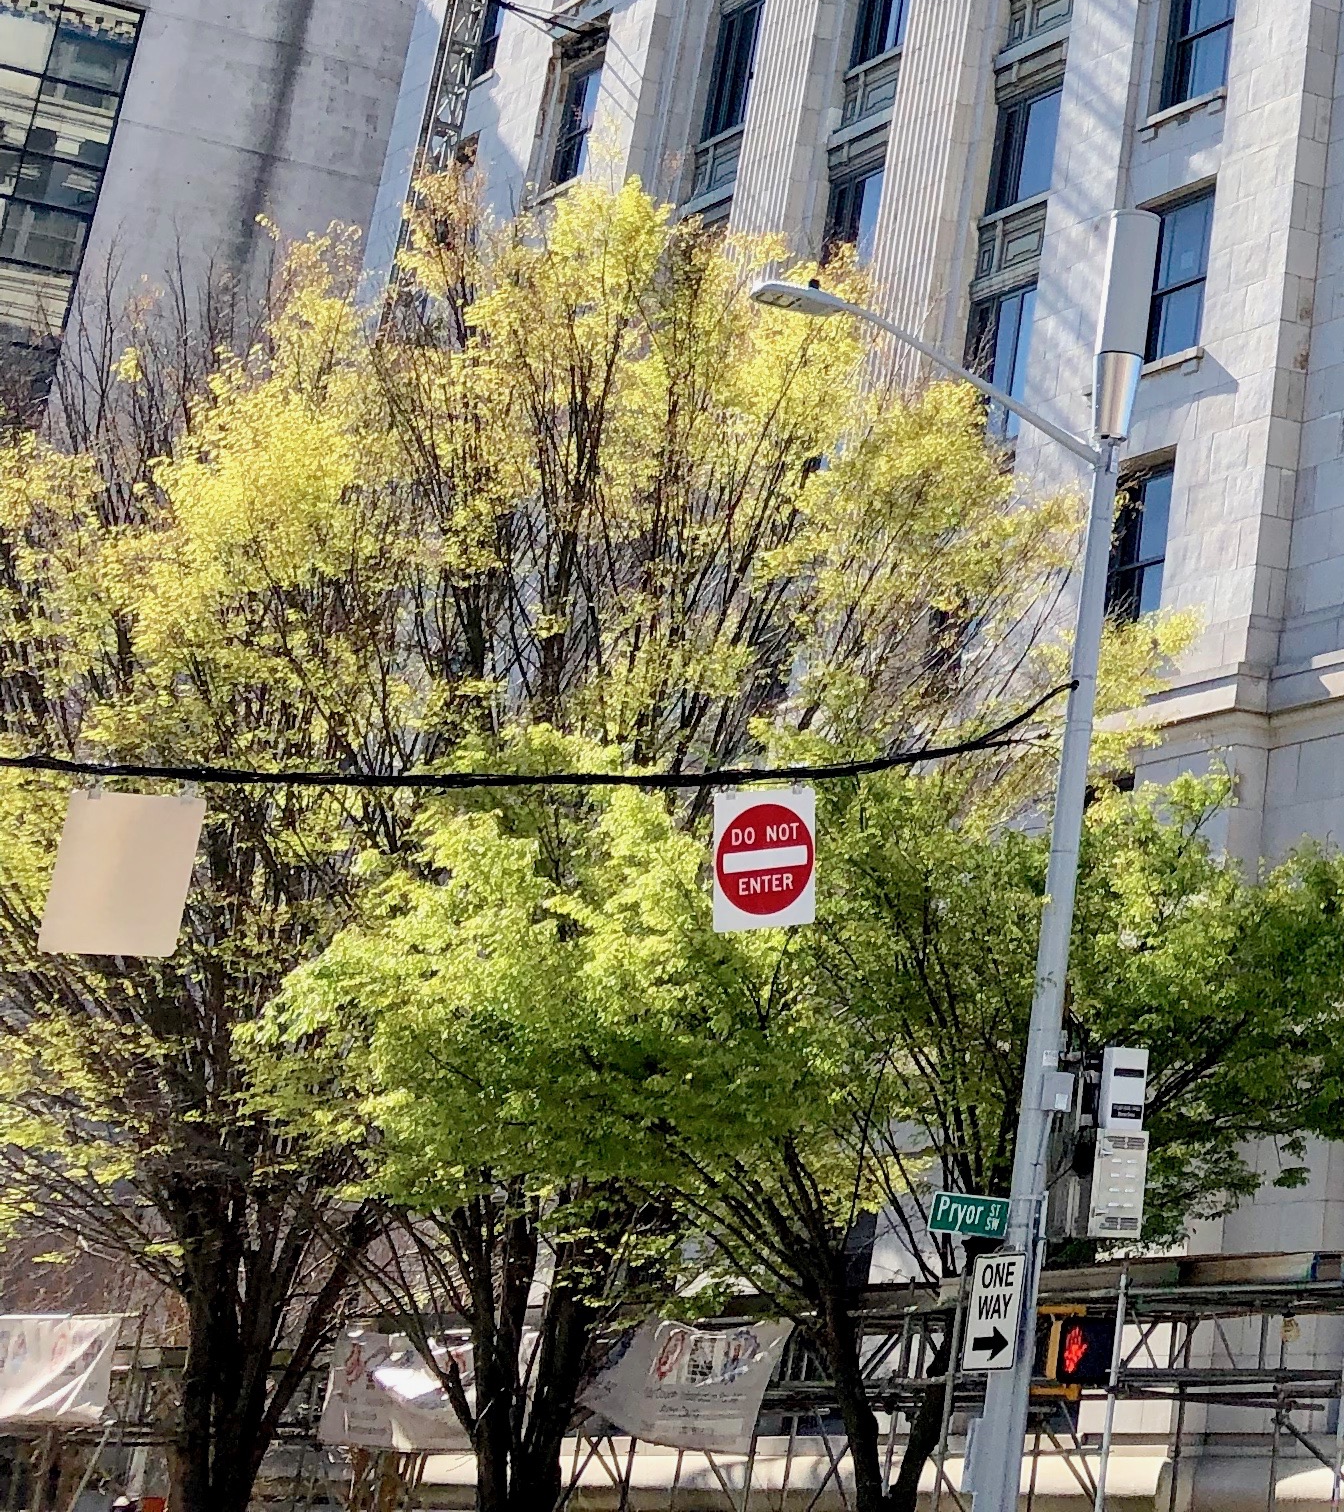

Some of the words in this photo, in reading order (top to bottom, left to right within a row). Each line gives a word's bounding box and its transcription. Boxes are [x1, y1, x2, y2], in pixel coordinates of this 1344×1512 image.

[731, 826, 755, 846] DO
[766, 822, 799, 842] NOT
[738, 873, 794, 896] ENTER
[936, 1195, 985, 1231] Pryor
[989, 1203, 1002, 1217] ST
[984, 1217, 1001, 1231] SW
[981, 1261, 1017, 1289] ONE
[978, 1292, 1014, 1321] WAY
